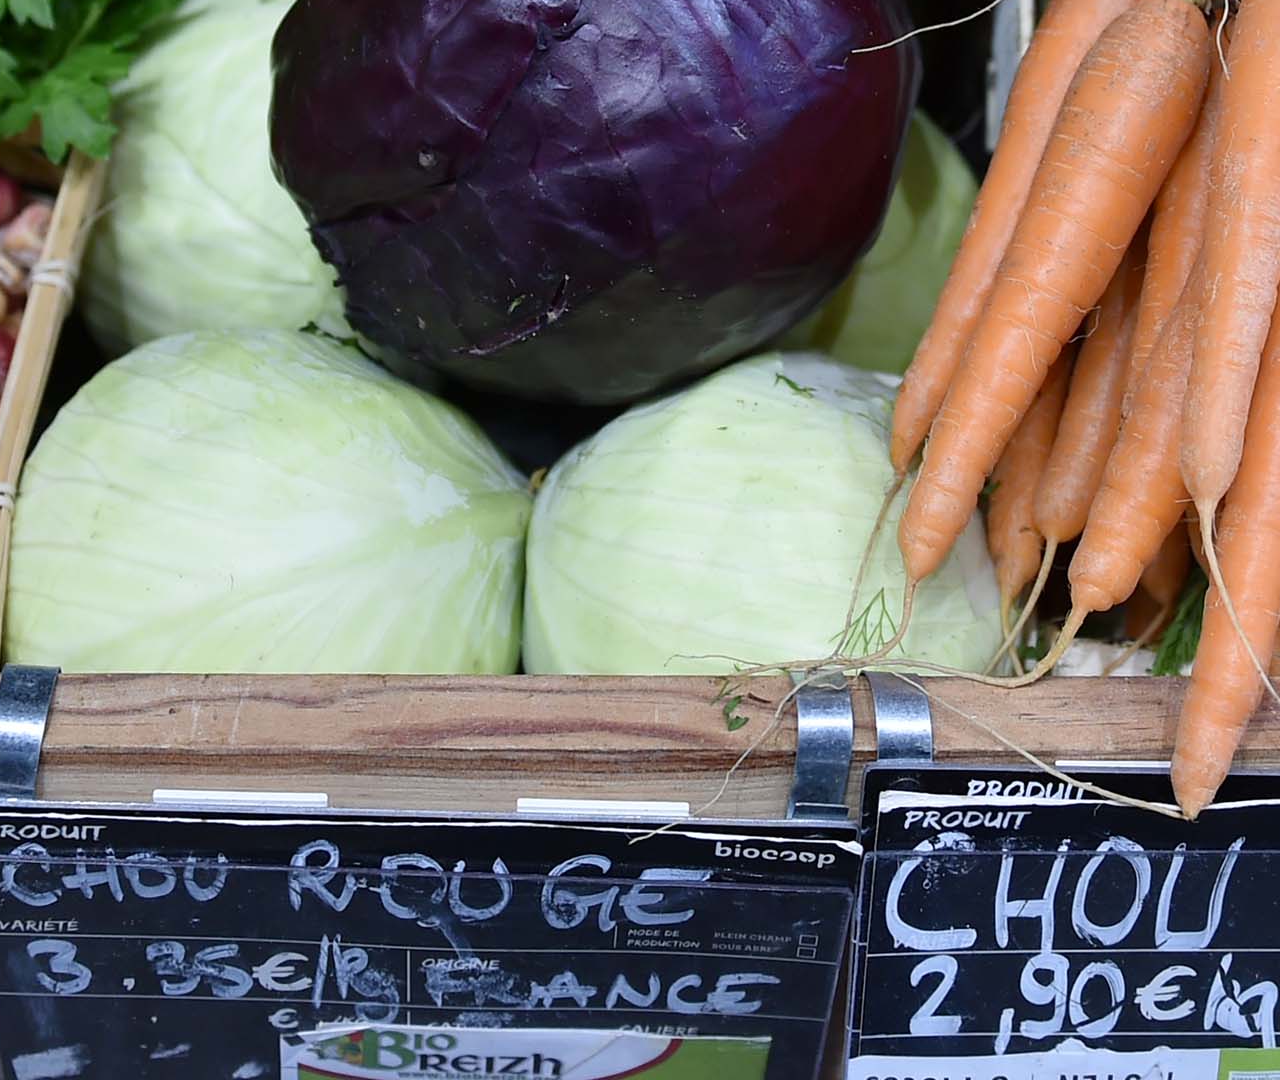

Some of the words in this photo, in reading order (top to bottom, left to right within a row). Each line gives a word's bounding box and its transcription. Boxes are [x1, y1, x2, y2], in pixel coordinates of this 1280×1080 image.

[904, 810, 1031, 830] PRODUIT
[715, 841, 836, 869] biocoop
[3, 842, 228, 906] CHOU
[885, 831, 1244, 954] CHOU
[627, 928, 661, 938] MODE
[664, 929, 680, 938] DE
[626, 938, 701, 949] PRODUCTION
[422, 957, 501, 972] ORIGINE
